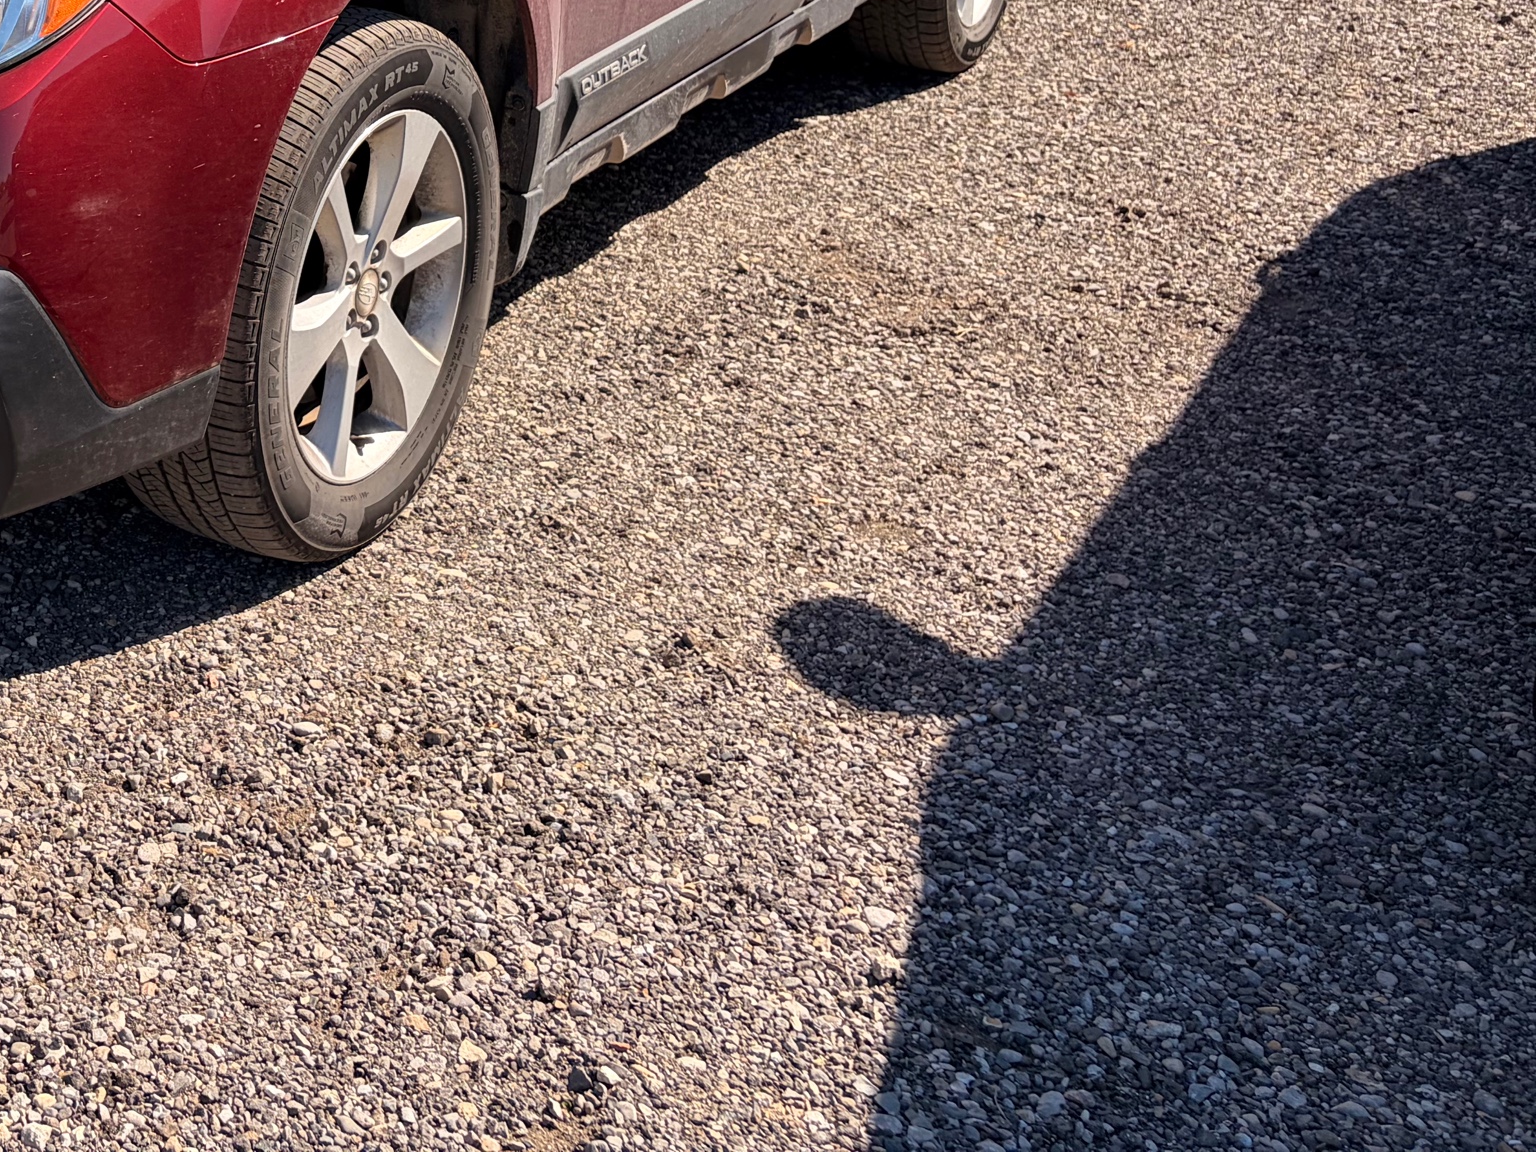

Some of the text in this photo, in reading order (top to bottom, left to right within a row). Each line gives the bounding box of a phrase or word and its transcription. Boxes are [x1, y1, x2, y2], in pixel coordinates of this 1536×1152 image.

[581, 44, 648, 95] OUTBACK
[314, 83, 378, 195] ALTIMAX
[268, 318, 294, 491] GENERAL
